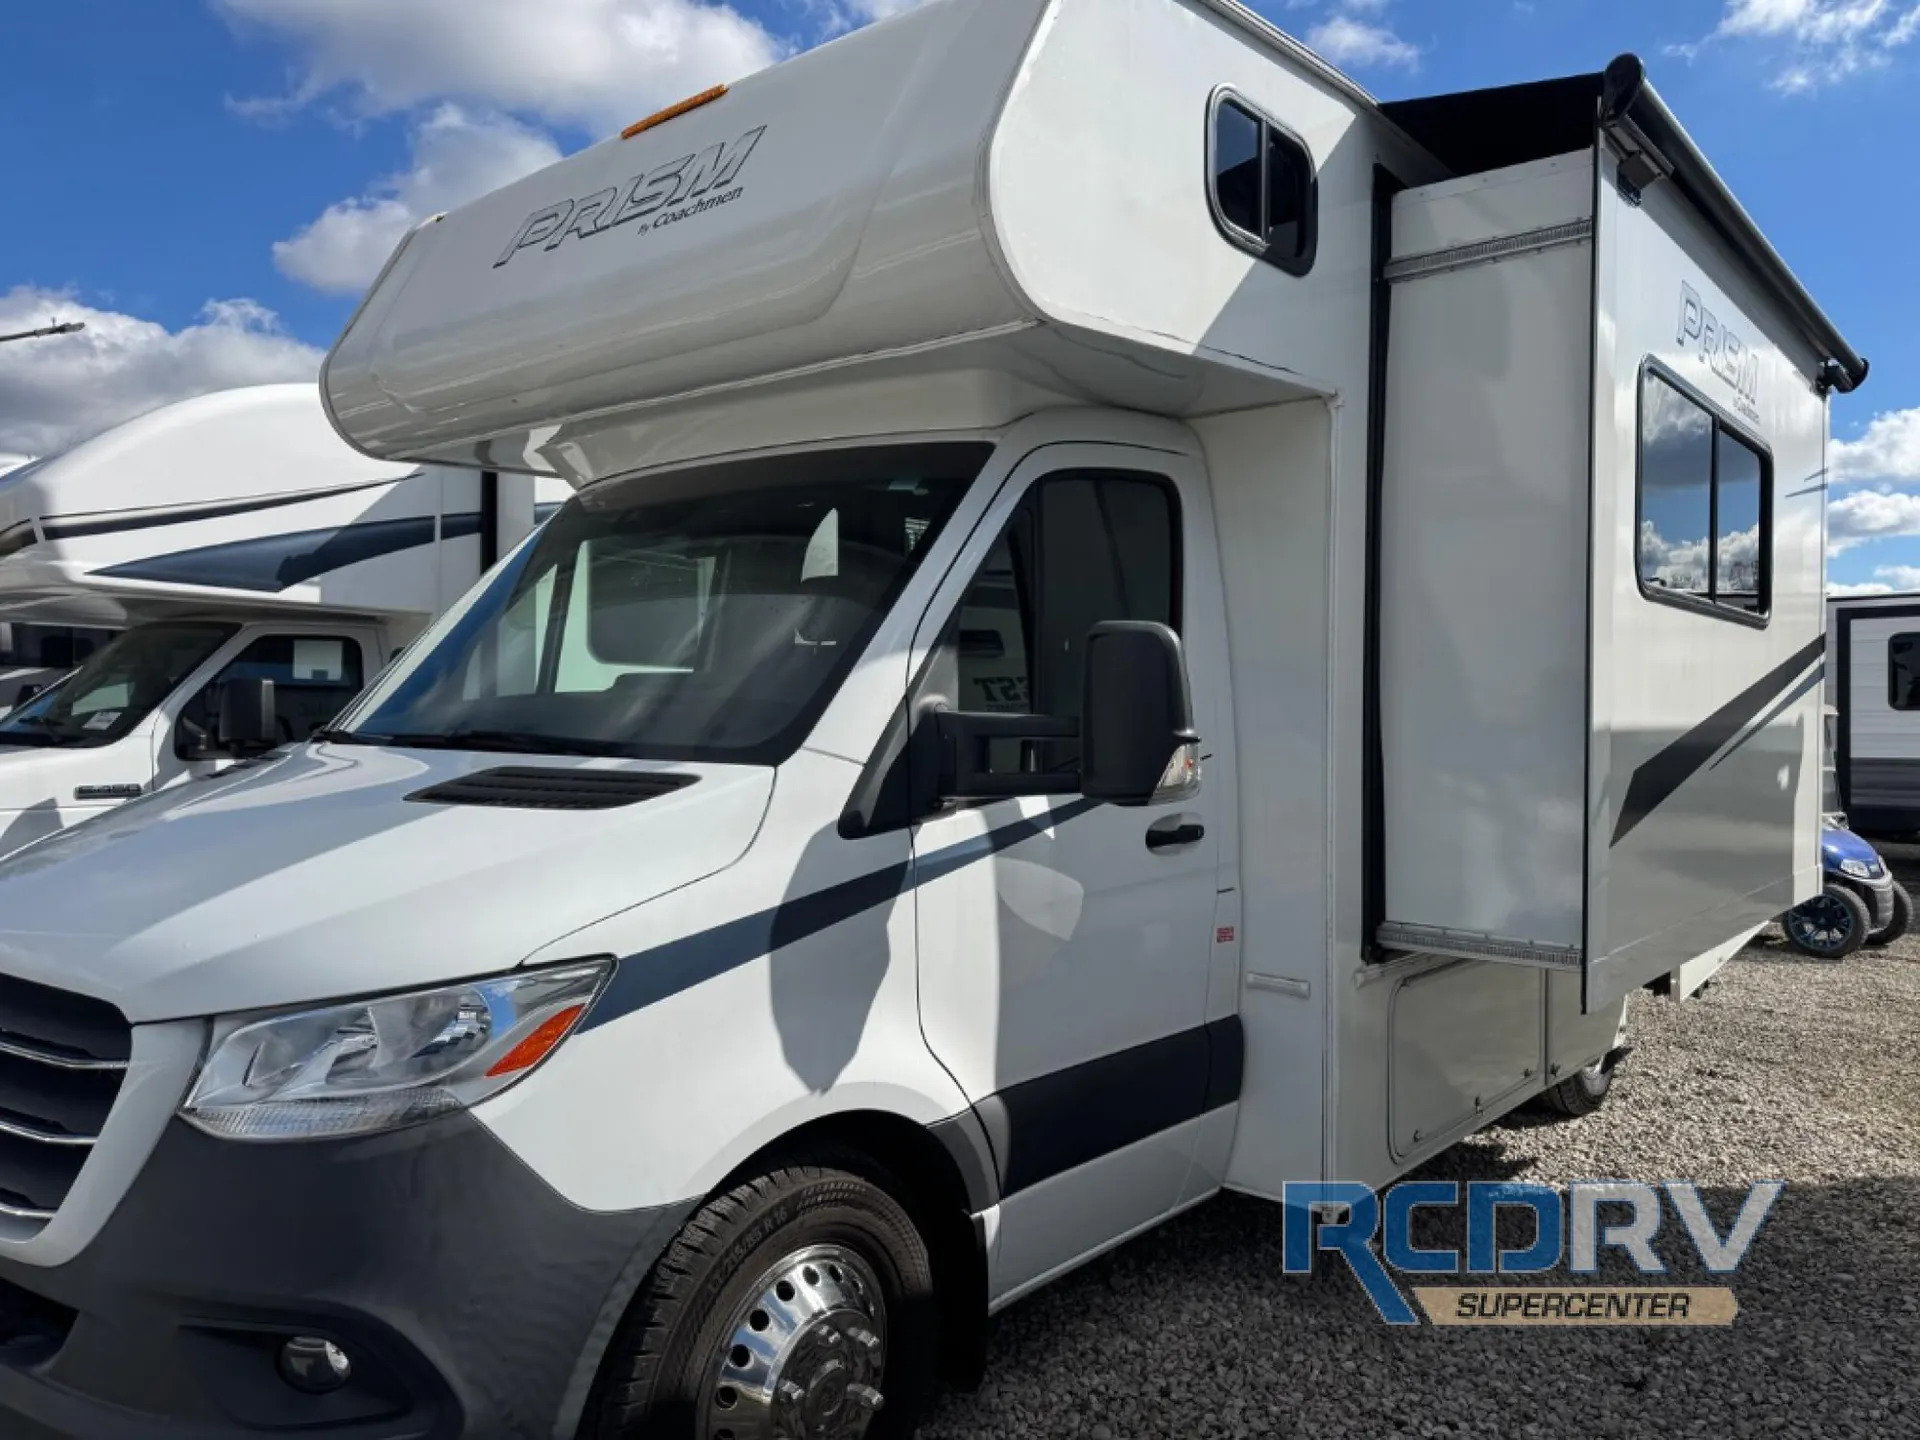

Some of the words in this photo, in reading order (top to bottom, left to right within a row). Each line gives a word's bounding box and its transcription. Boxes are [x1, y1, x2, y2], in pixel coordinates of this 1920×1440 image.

[493, 124, 767, 268] PRISM
[653, 186, 743, 230] Coachmen
[1676, 279, 1759, 405] PRISM
